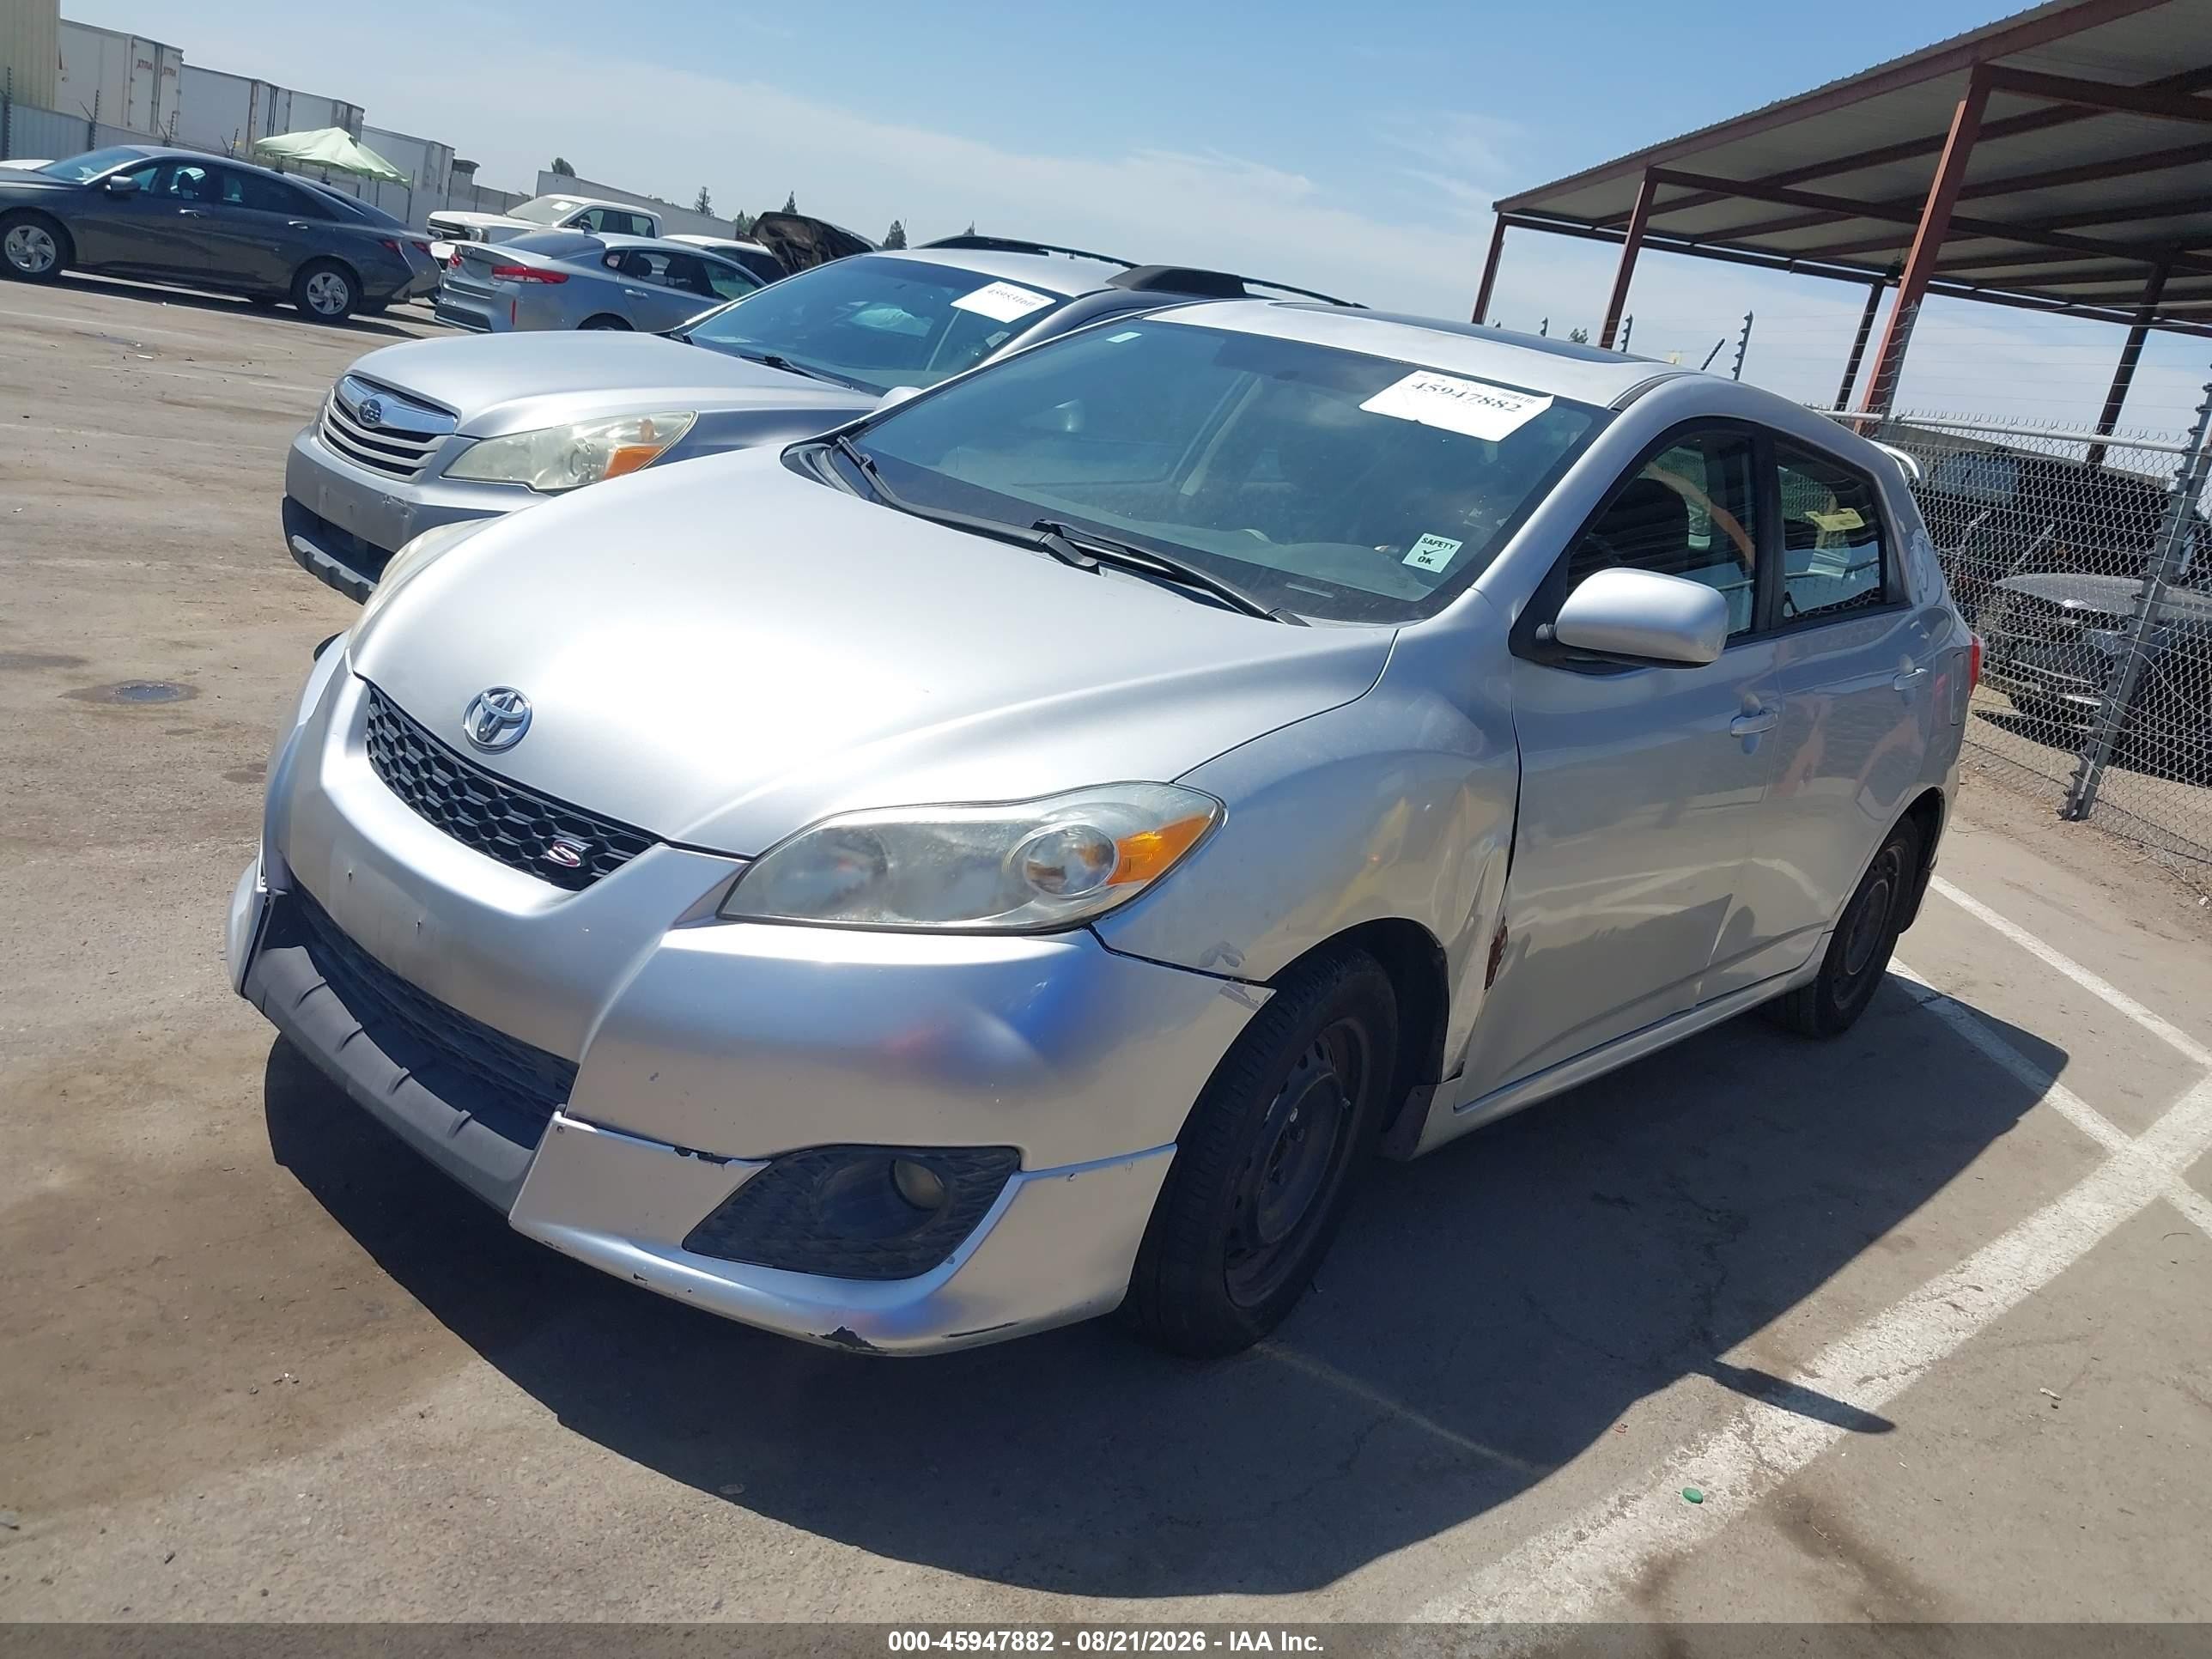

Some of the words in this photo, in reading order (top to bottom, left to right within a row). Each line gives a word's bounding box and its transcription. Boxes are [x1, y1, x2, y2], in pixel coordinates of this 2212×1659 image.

[1411, 381, 1522, 412] 45947882
[1421, 537, 1456, 550] SAFETY
[1417, 556, 1435, 565] OK
